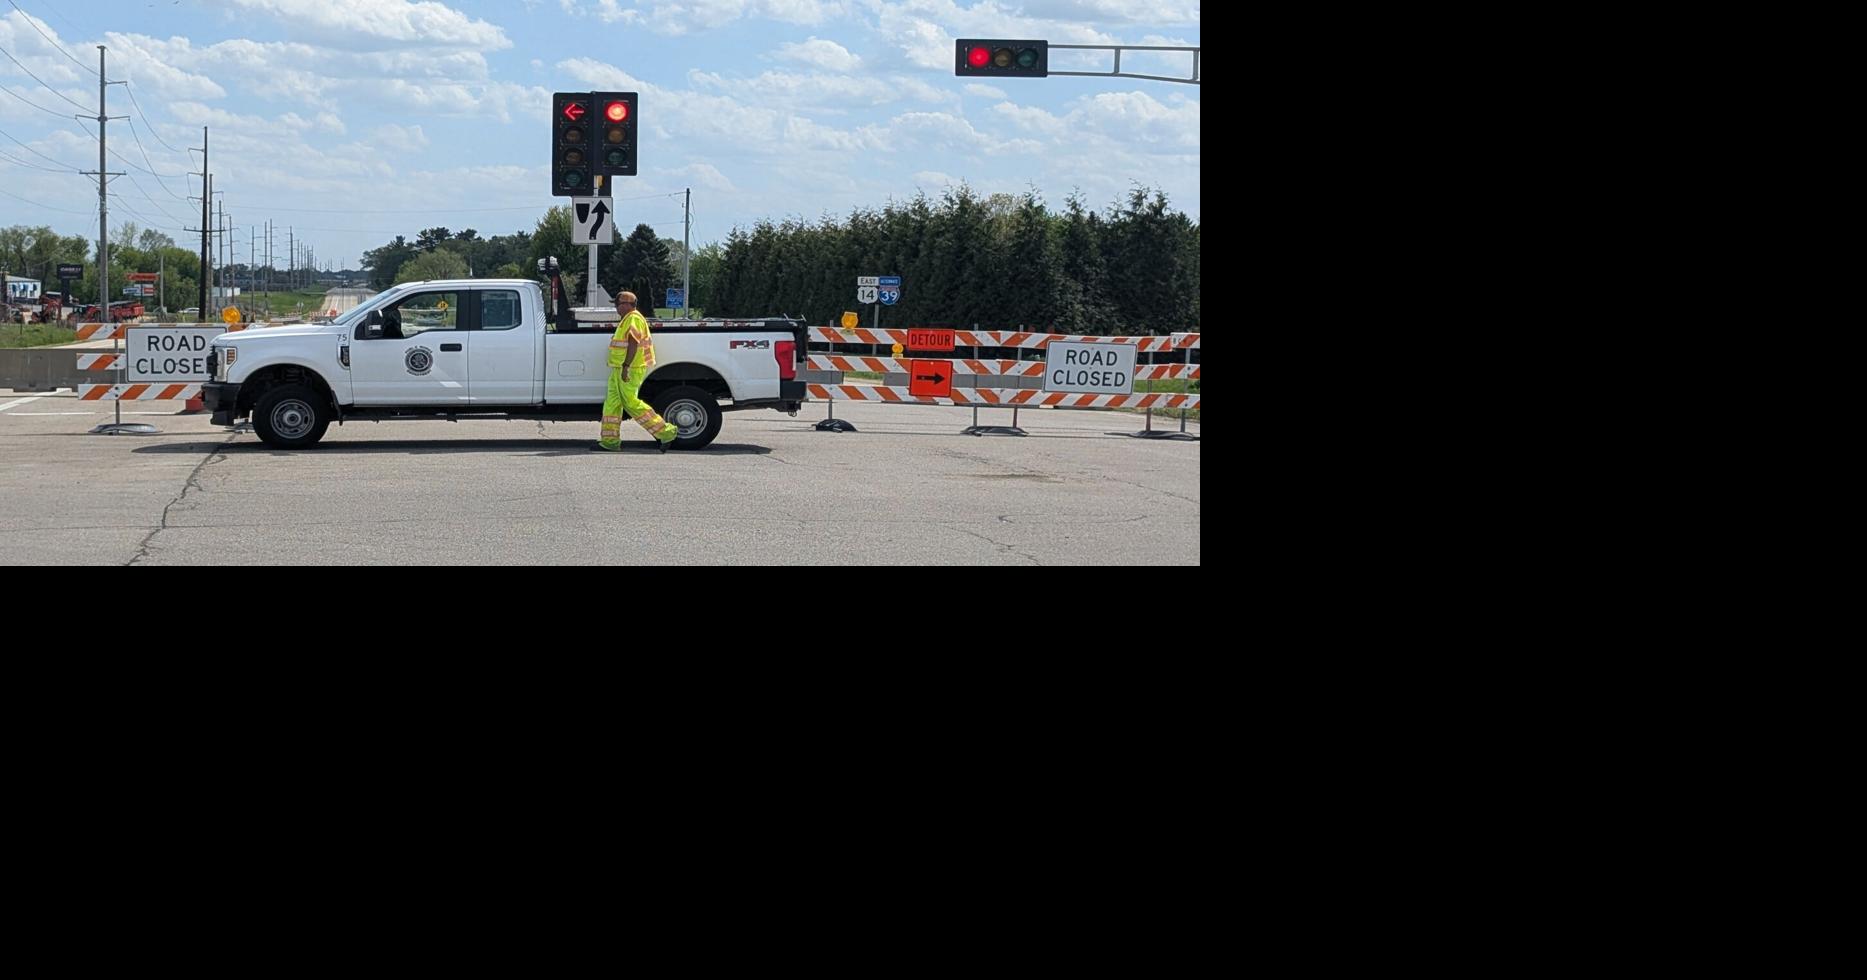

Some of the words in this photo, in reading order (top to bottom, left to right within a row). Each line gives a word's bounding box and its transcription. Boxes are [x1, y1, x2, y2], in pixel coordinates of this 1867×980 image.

[861, 290, 874, 300] 14
[881, 291, 898, 301] 39
[147, 335, 206, 352] ROAD
[337, 334, 348, 342] 75
[730, 340, 770, 349] FX4
[911, 334, 951, 347] DETOUR
[1065, 349, 1118, 366] ROAD
[136, 358, 208, 375] CLOSE
[1053, 369, 1126, 387] CLOSED
